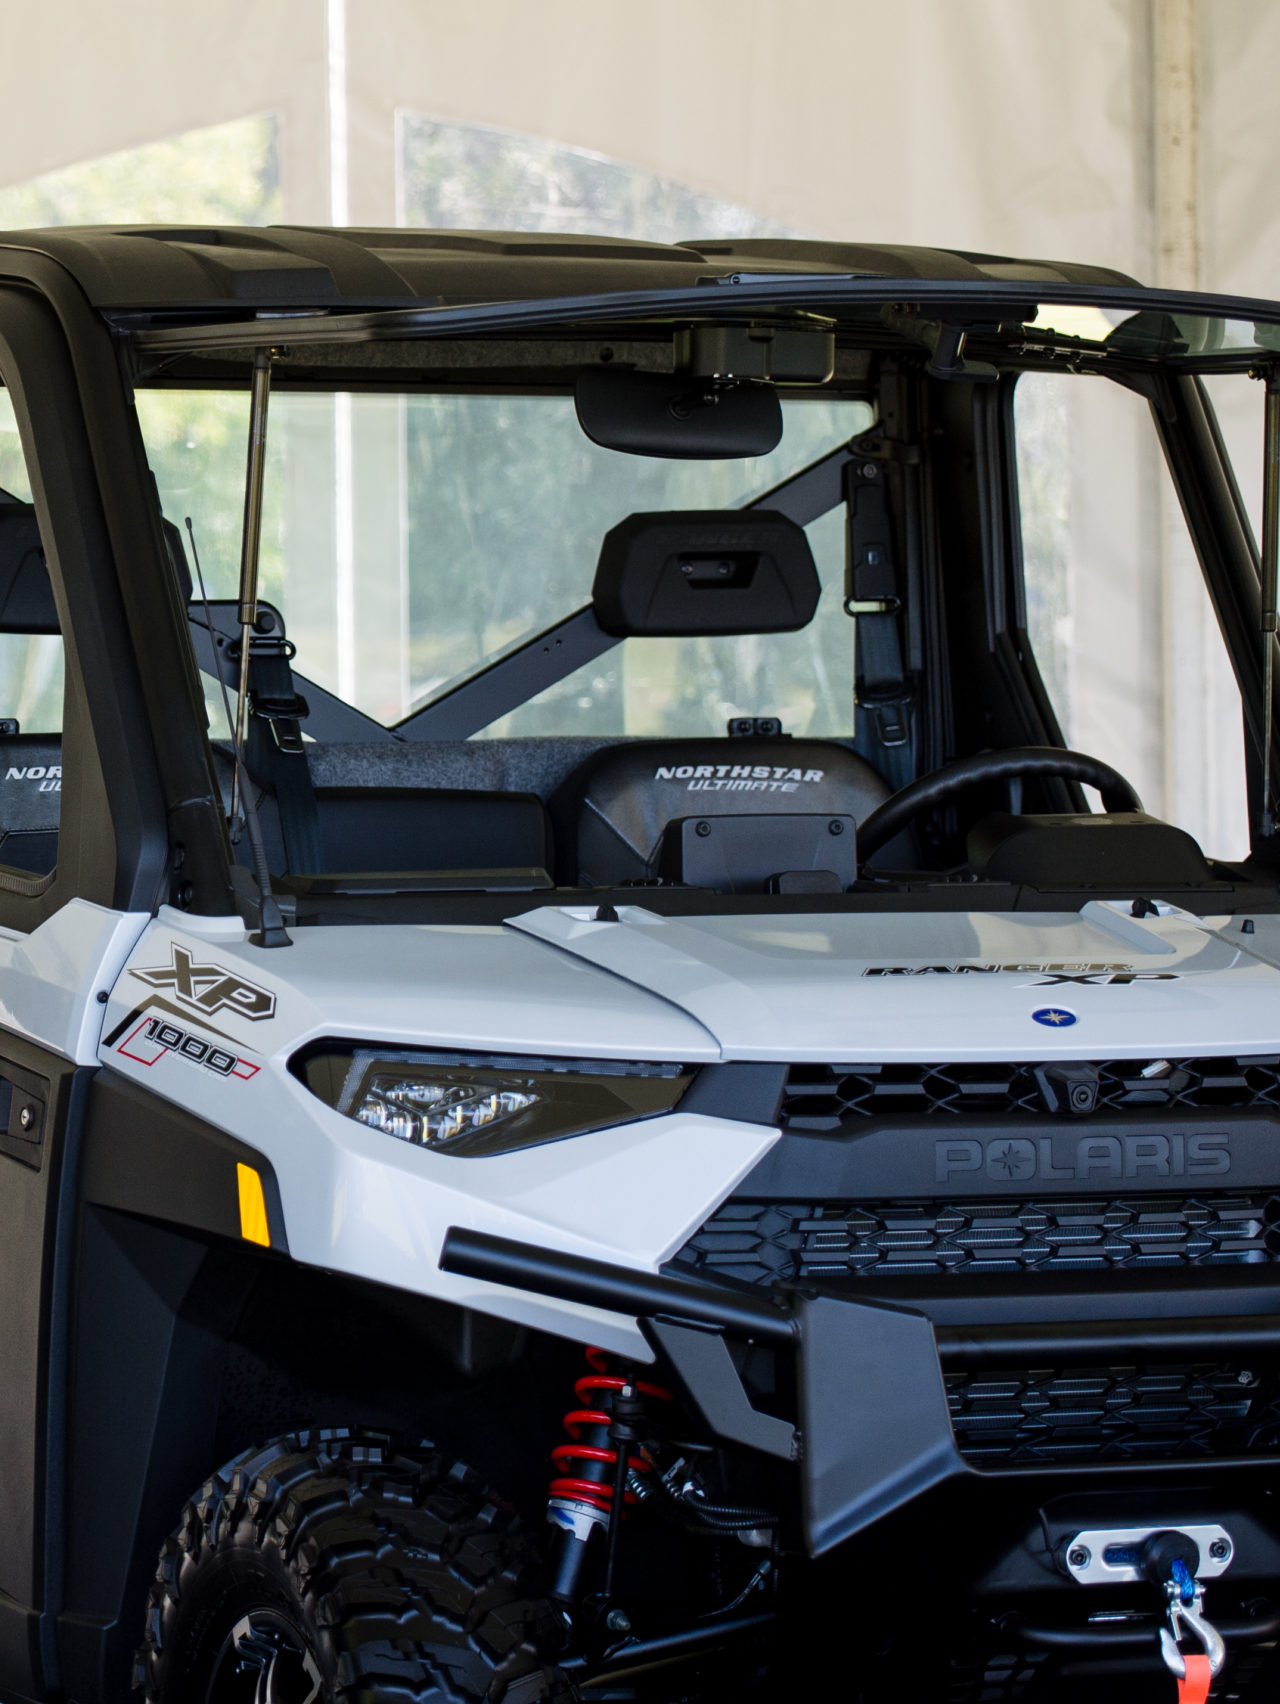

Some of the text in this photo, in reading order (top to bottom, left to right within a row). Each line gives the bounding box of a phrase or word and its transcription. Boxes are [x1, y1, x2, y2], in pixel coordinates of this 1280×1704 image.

[654, 765, 824, 783] NORTHSTAR
[686, 779, 800, 793] ULTIMATE
[861, 962, 1134, 977] RANGER
[127, 941, 277, 1022] XP
[1012, 972, 1182, 989] XP
[144, 1016, 238, 1077] 1000
[934, 1132, 1232, 1184] POLARIS
